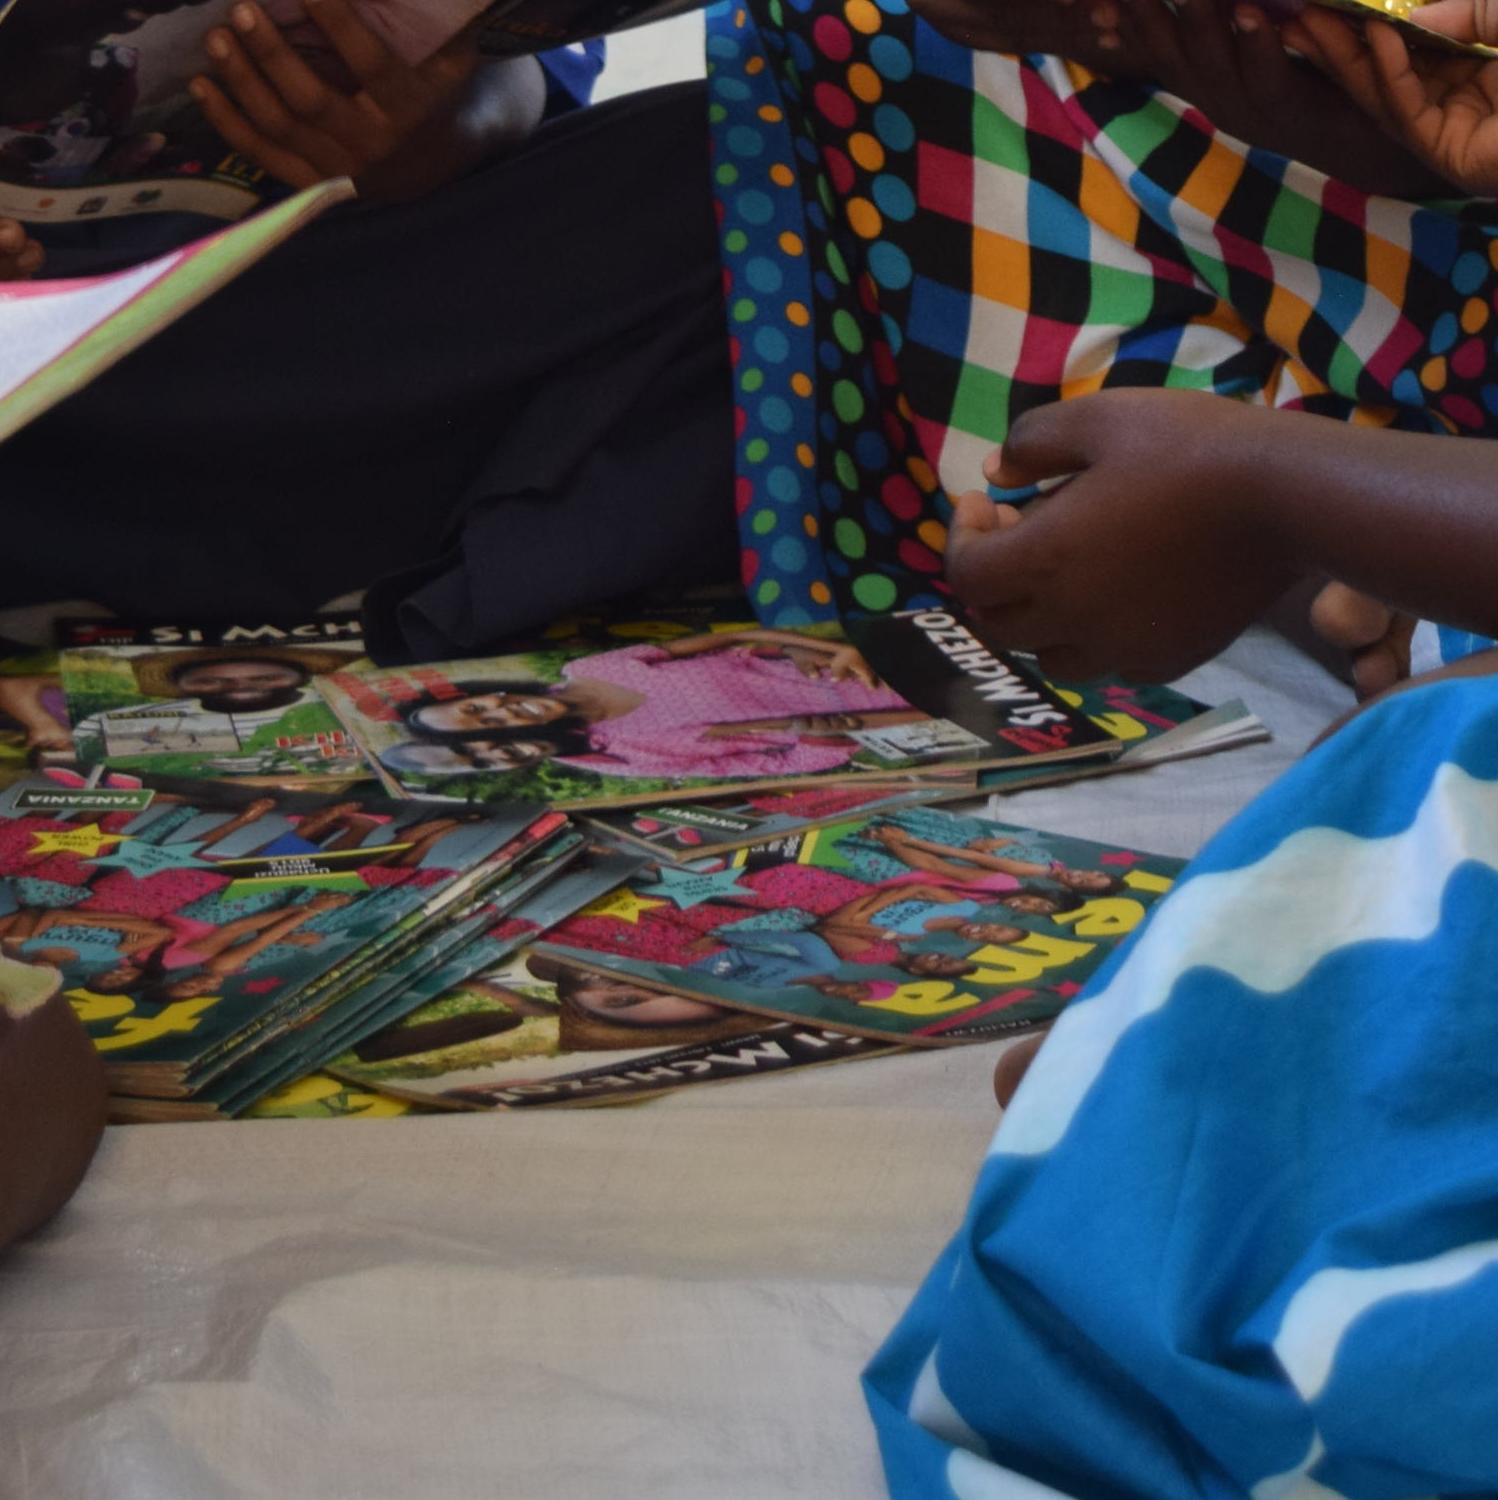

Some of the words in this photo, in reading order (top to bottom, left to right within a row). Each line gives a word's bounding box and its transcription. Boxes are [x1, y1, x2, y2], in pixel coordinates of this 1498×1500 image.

[151, 625, 203, 643] SI
[222, 620, 362, 642] MCH
[892, 606, 1041, 701] MCHEZO!
[1006, 703, 1068, 726] SI
[27, 793, 142, 806] TANZANIA
